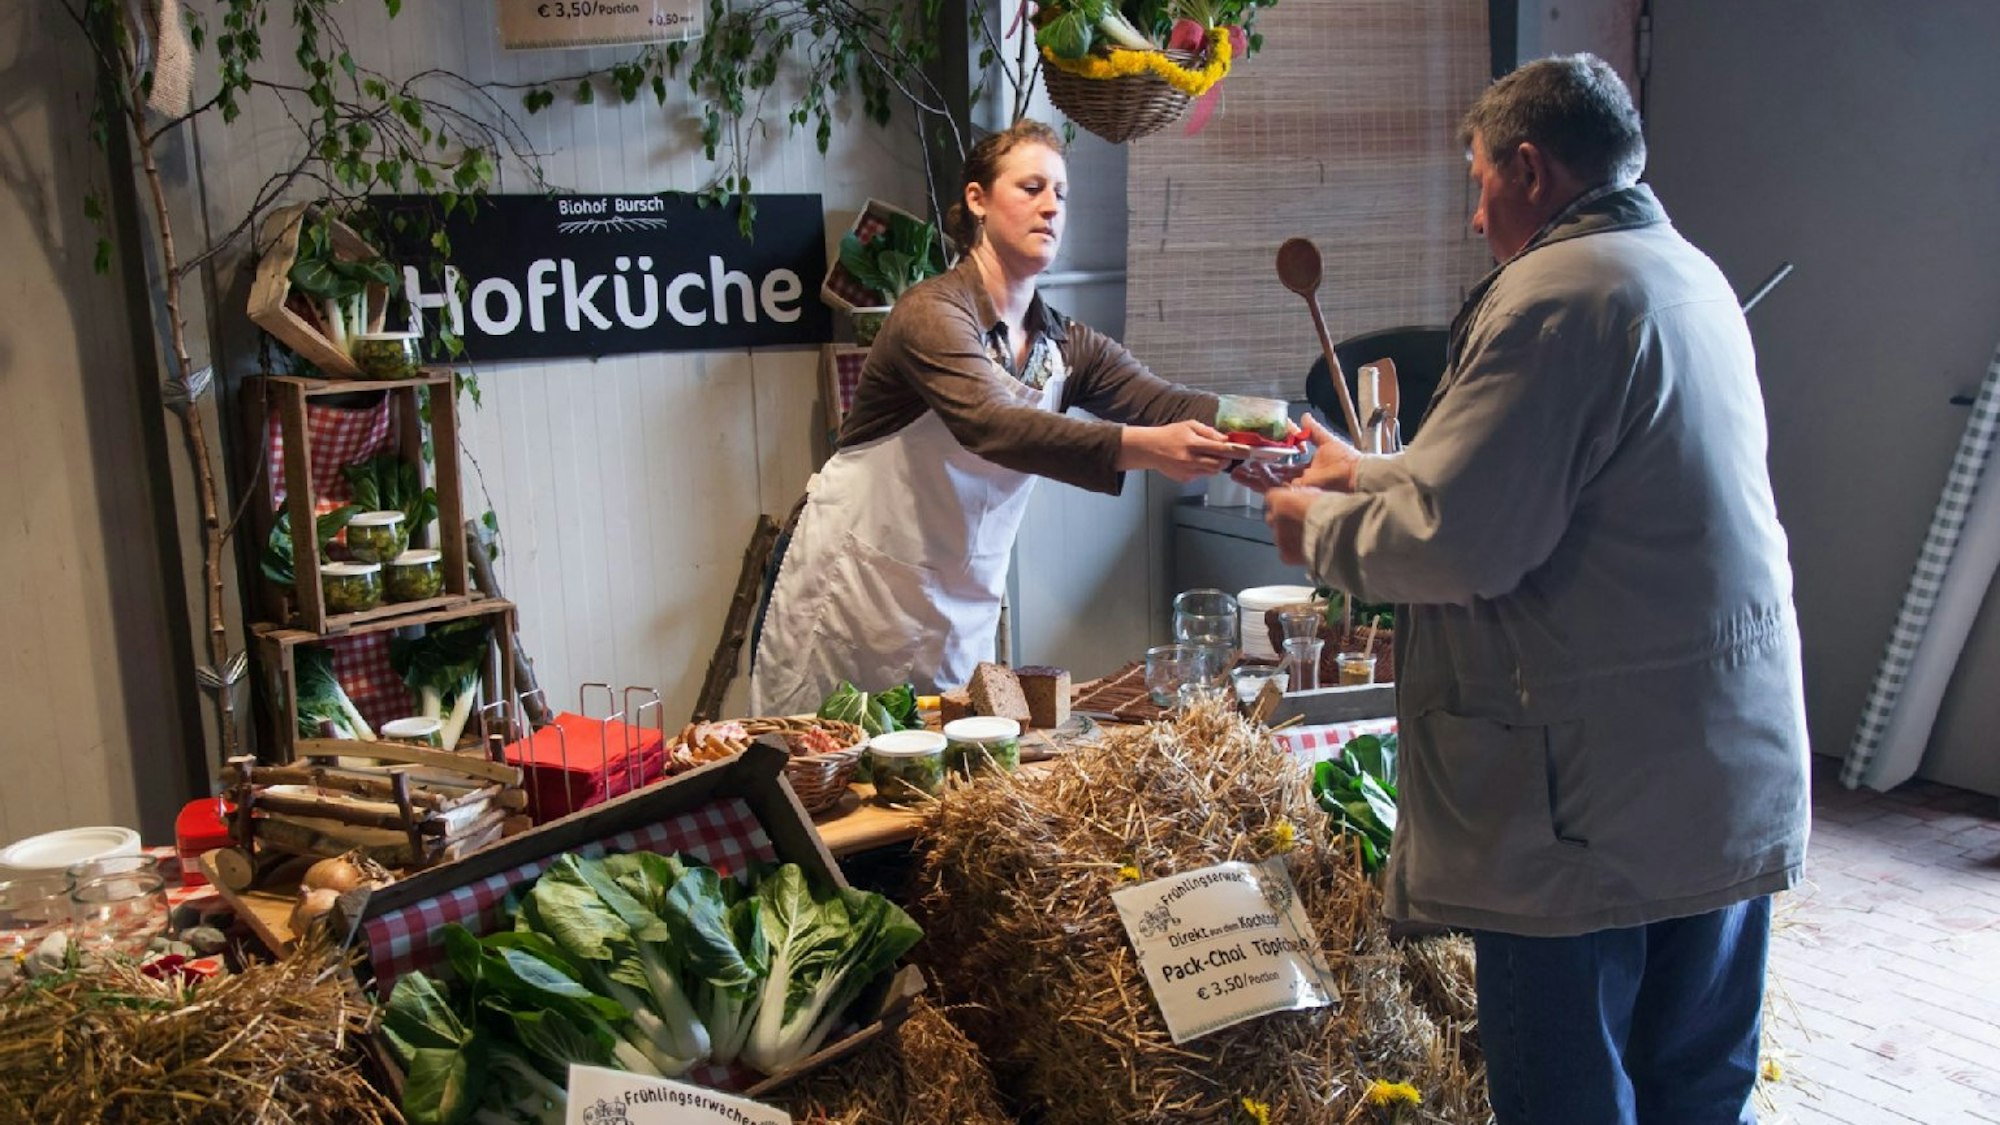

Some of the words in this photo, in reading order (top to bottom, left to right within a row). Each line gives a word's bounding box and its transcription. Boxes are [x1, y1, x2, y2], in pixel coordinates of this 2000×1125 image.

[537, 4, 551, 18] €
[555, 1, 639, 19] 3,50/Portion
[656, 13, 679, 26] 0,50
[558, 198, 608, 216] Biohof
[614, 196, 664, 213] Bursch
[403, 255, 803, 336] Hofküche
[1168, 927, 1209, 948] Direkt
[1162, 944, 1247, 983] Pack-Choi
[1197, 986, 1210, 1000] €
[1213, 970, 1280, 997] 3,50/Portion
